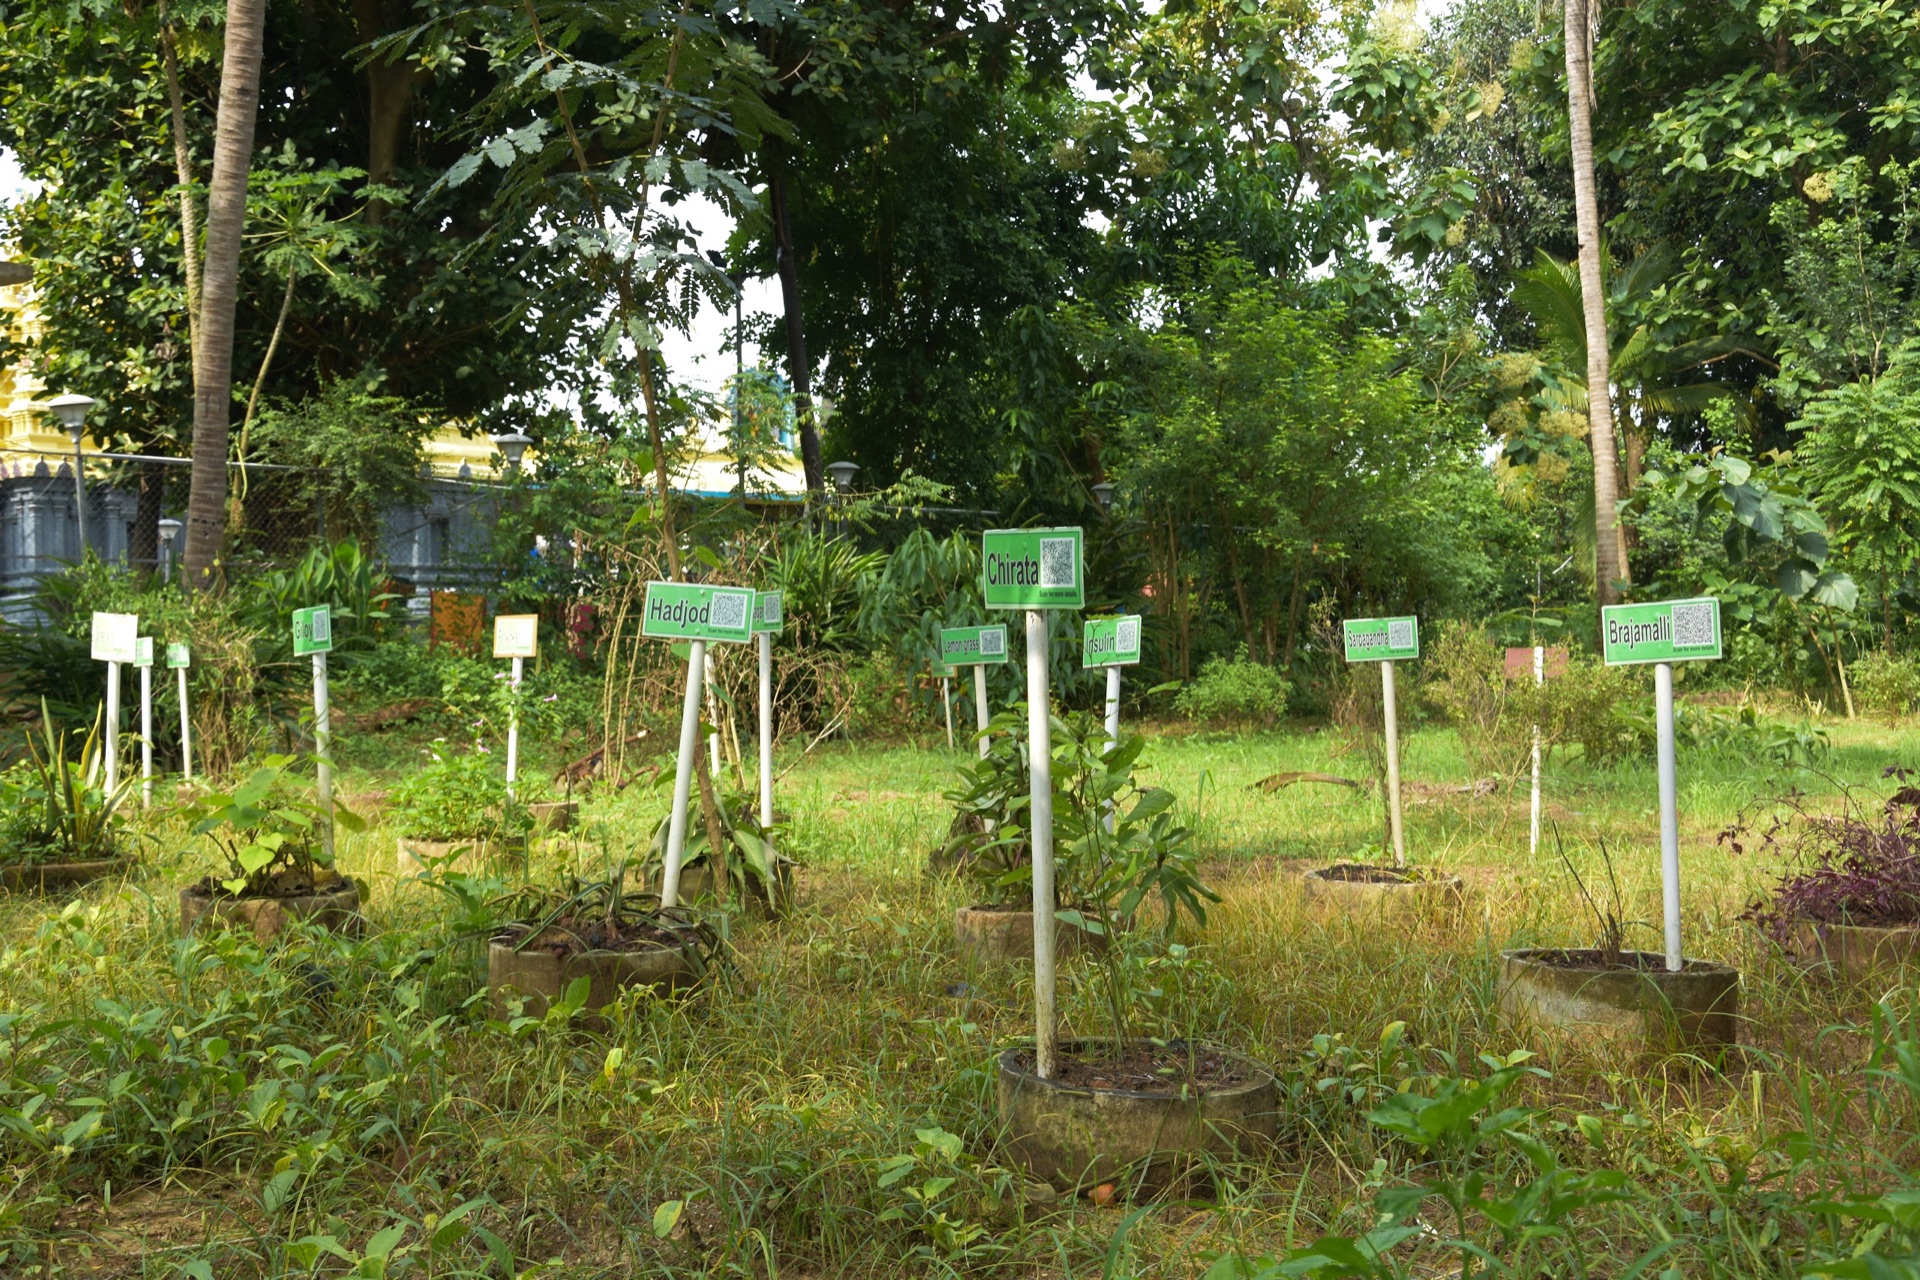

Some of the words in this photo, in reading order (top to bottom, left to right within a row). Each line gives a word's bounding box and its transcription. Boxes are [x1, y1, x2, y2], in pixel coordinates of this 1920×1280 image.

[987, 552, 1039, 586] Chirata
[650, 598, 710, 629] Hadjod
[295, 621, 313, 642] Giloy
[1086, 632, 1115, 653] Insulin
[1348, 628, 1388, 651] Sarpagandha
[1609, 616, 1671, 650] Brajamalli
[944, 638, 962, 653] Lemon
[964, 639, 980, 655] grass
